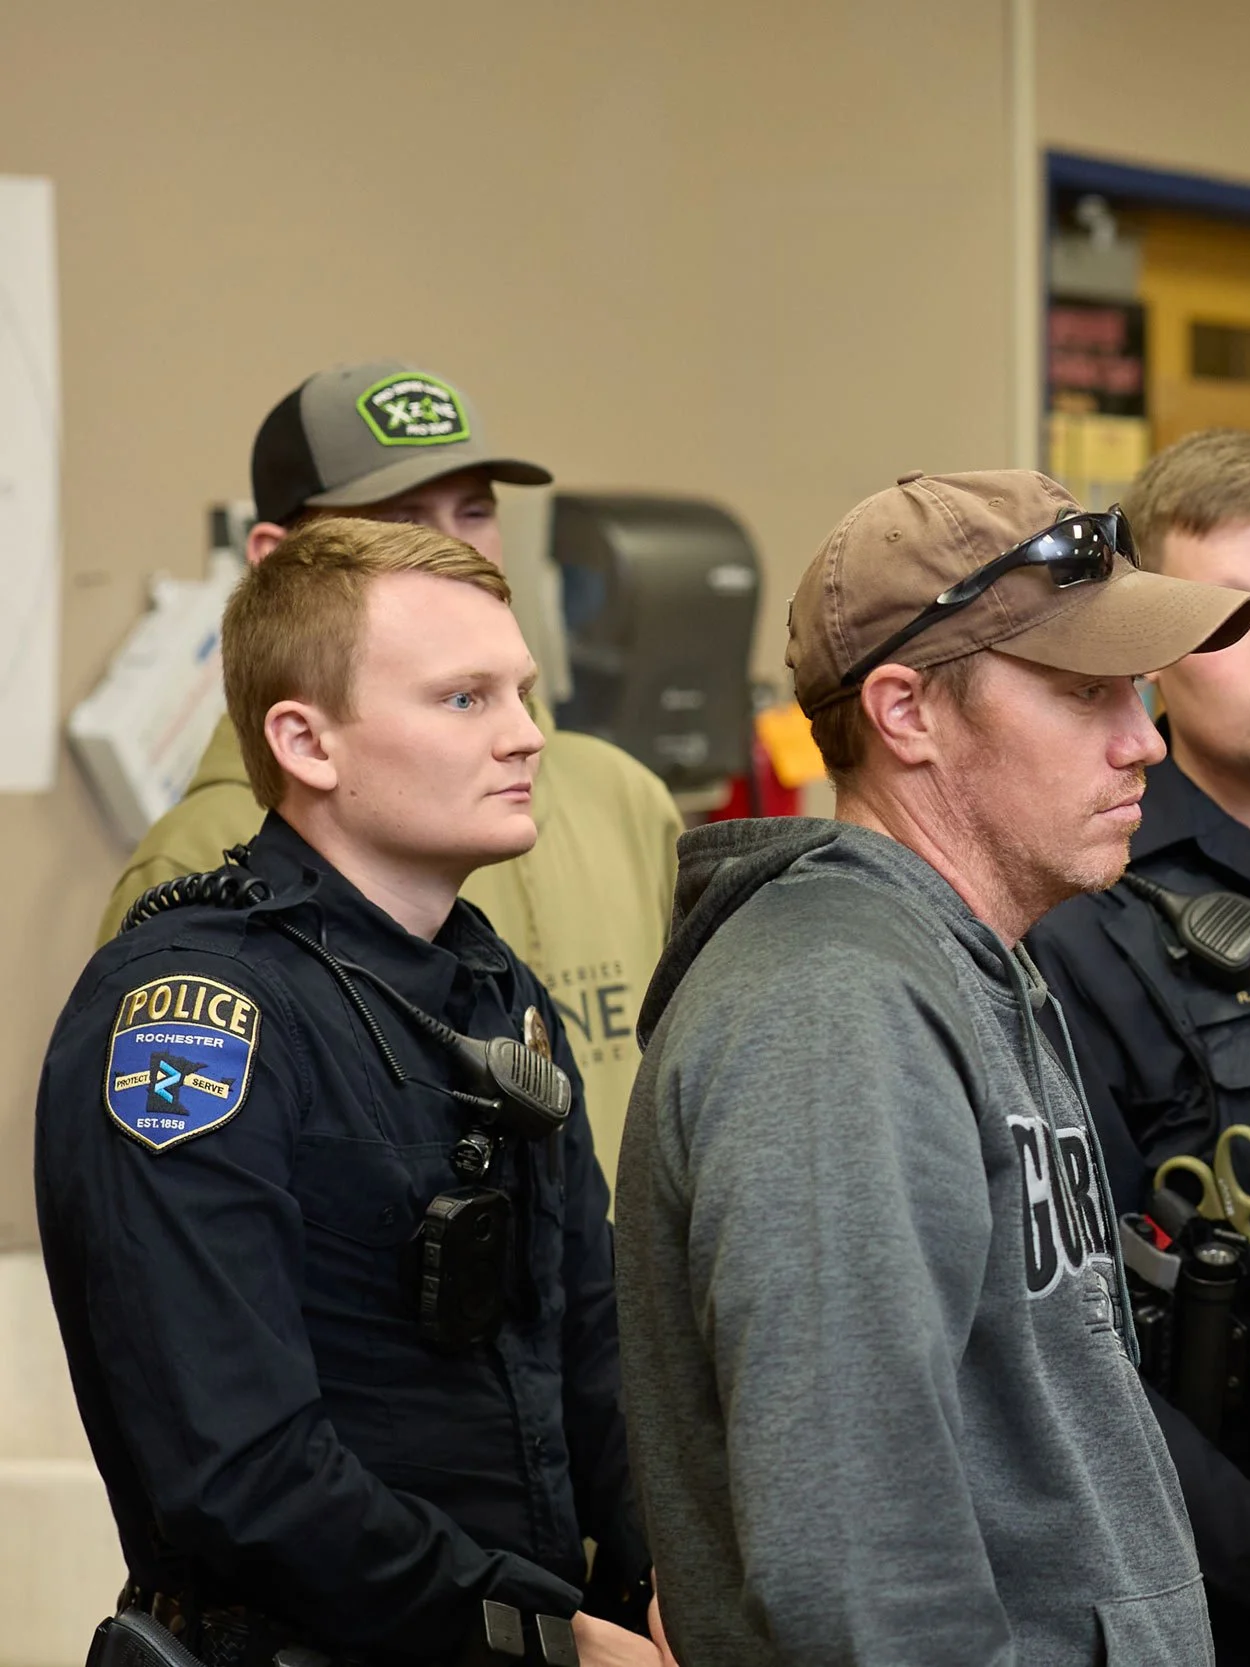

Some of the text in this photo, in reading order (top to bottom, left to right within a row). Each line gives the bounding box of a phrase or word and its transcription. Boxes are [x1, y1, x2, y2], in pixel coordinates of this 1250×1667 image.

[125, 983, 251, 1035] POLICE
[135, 1033, 225, 1048] ROCHESTER
[116, 1074, 149, 1088] PROTECT
[192, 1077, 225, 1096] SERVE
